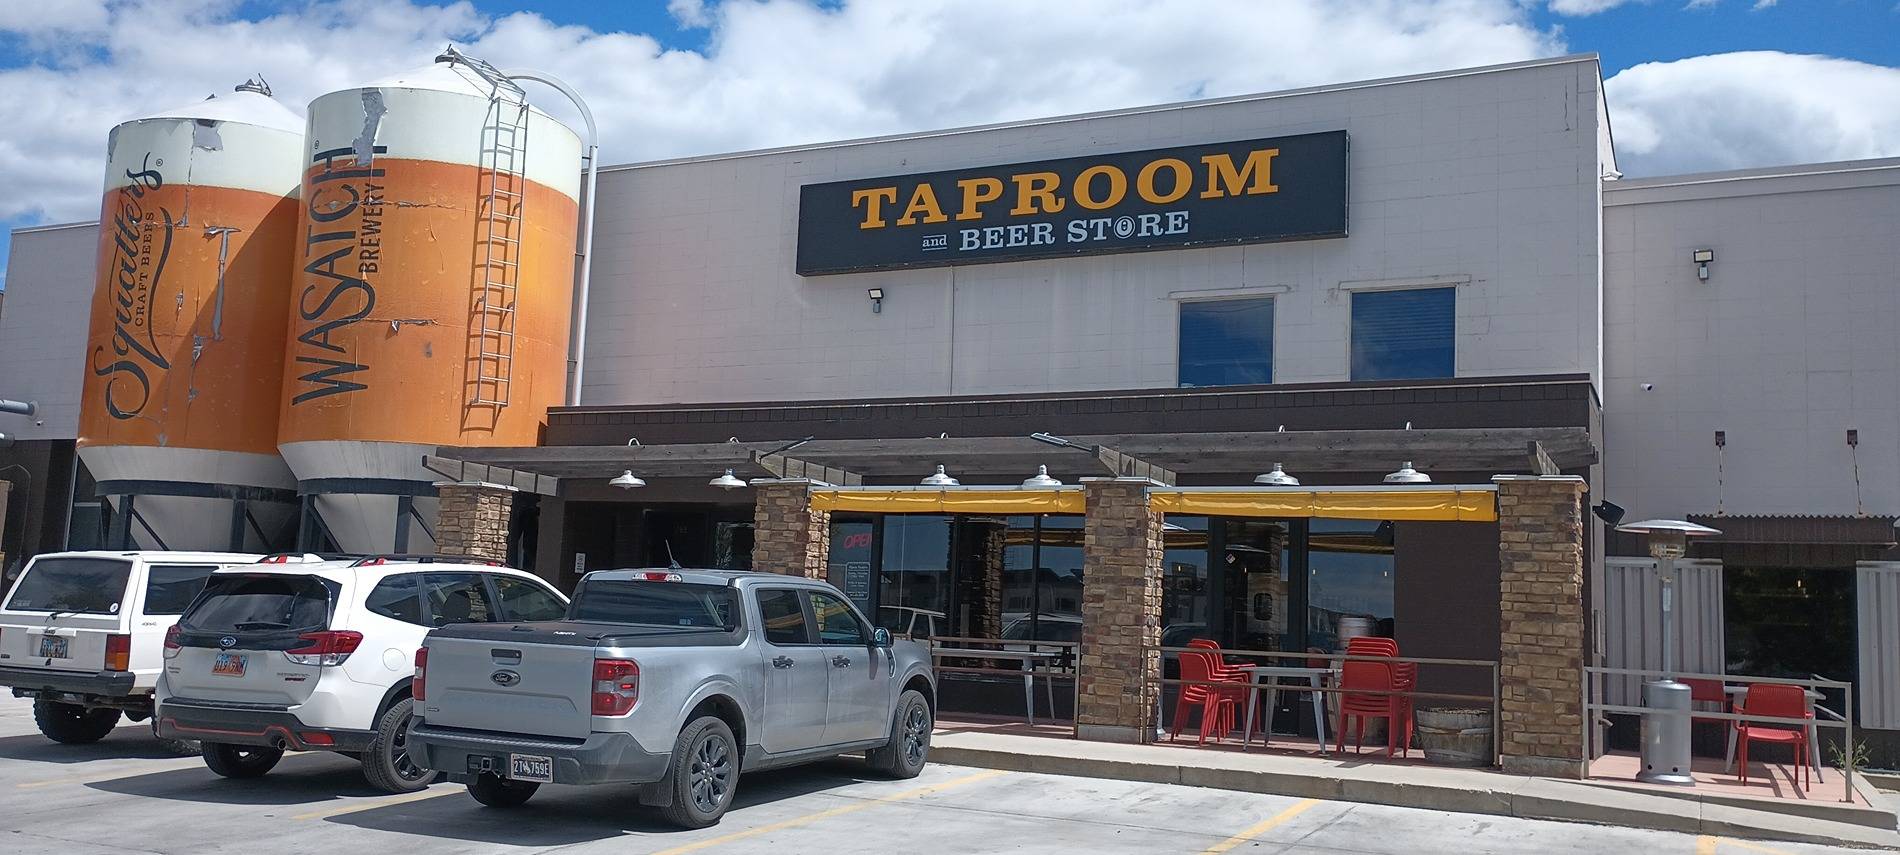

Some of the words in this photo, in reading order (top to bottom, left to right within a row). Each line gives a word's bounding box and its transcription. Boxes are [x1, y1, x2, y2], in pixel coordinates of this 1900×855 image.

[852, 148, 1280, 230] TAPROOM
[140, 211, 155, 267] BEERS
[358, 182, 386, 274] BREWERY
[922, 234, 948, 248] and
[959, 222, 1056, 251] BEER
[1067, 210, 1189, 243] STORE
[134, 271, 150, 328] CRAFT
[292, 146, 388, 406] WASATCH
